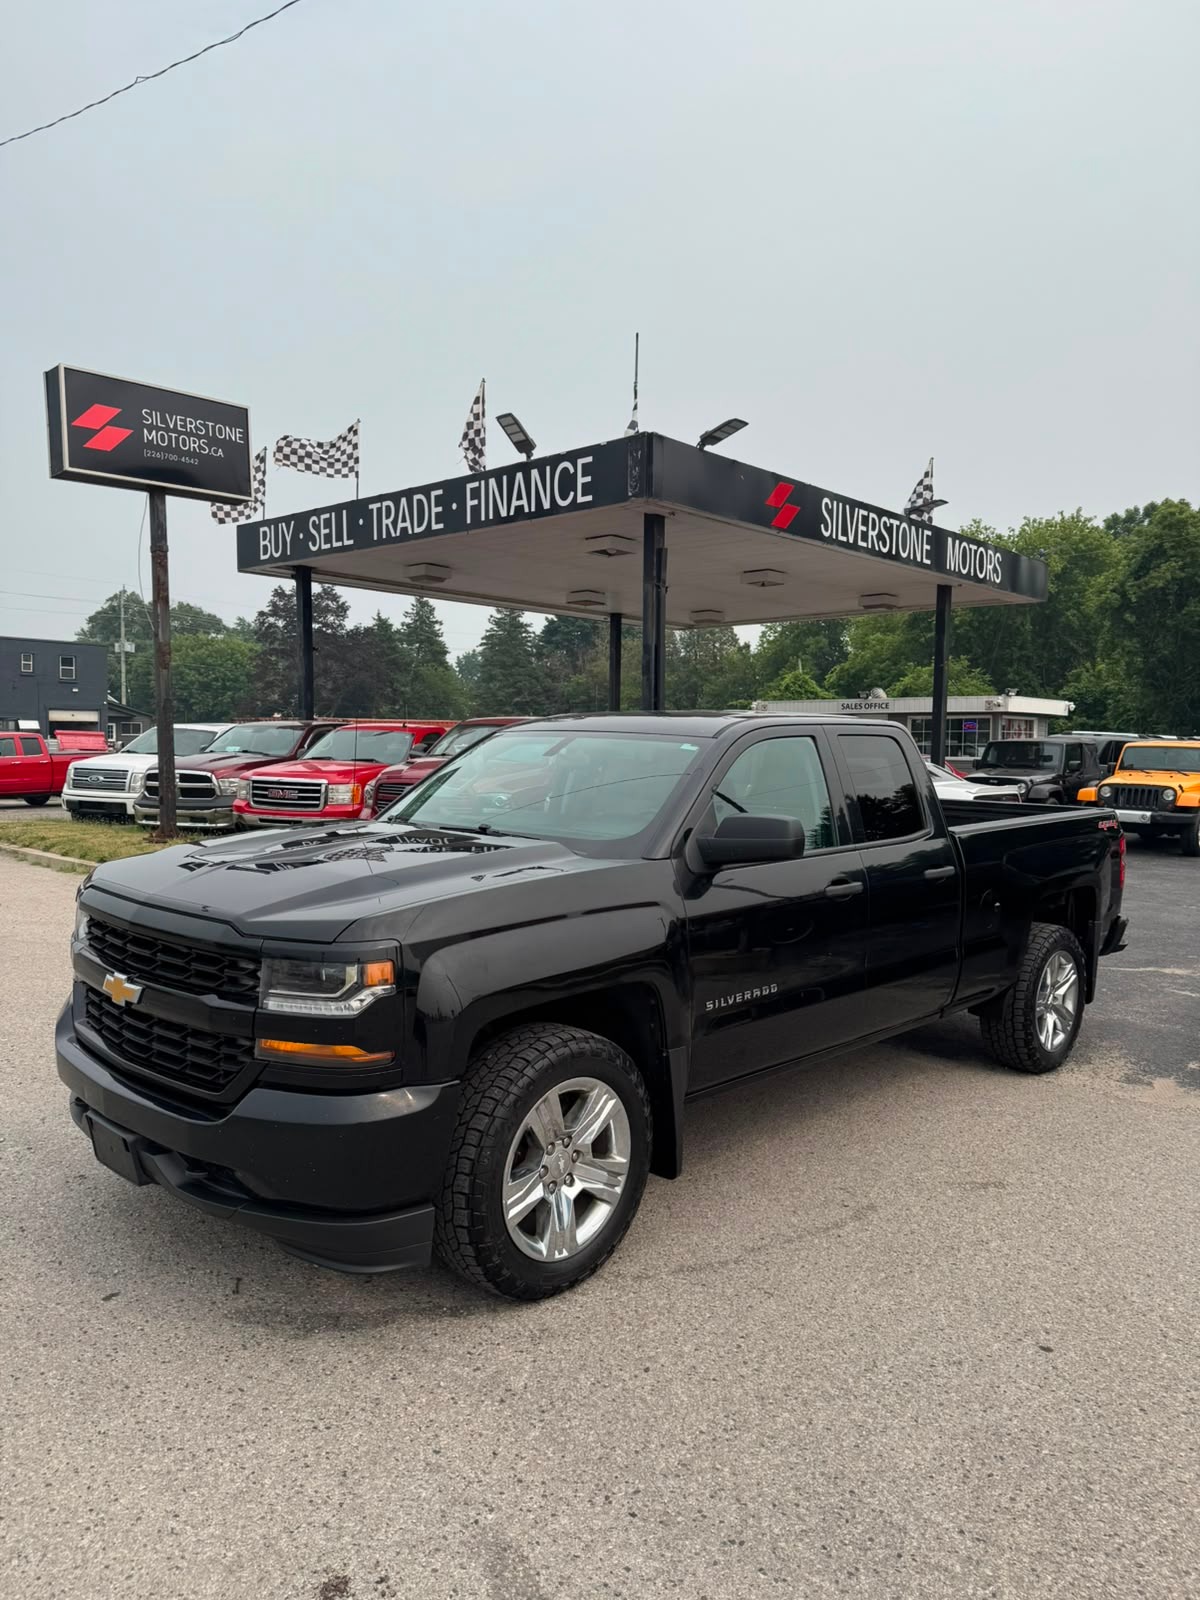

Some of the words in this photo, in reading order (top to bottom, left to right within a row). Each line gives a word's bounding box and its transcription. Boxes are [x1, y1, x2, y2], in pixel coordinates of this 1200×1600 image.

[142, 408, 244, 444] SILVERSTONE
[143, 428, 224, 457] MOTORS.CA
[143, 449, 199, 465] (226)700-4542
[258, 520, 295, 560] BUY
[308, 509, 354, 552] SELL
[368, 488, 445, 541] TRADE
[465, 456, 594, 524] FINANCE
[820, 497, 932, 565] SILVERSTONE
[945, 537, 1002, 584] MOTORS
[268, 789, 298, 799] GMC
[705, 983, 778, 1011] SILVERADO
